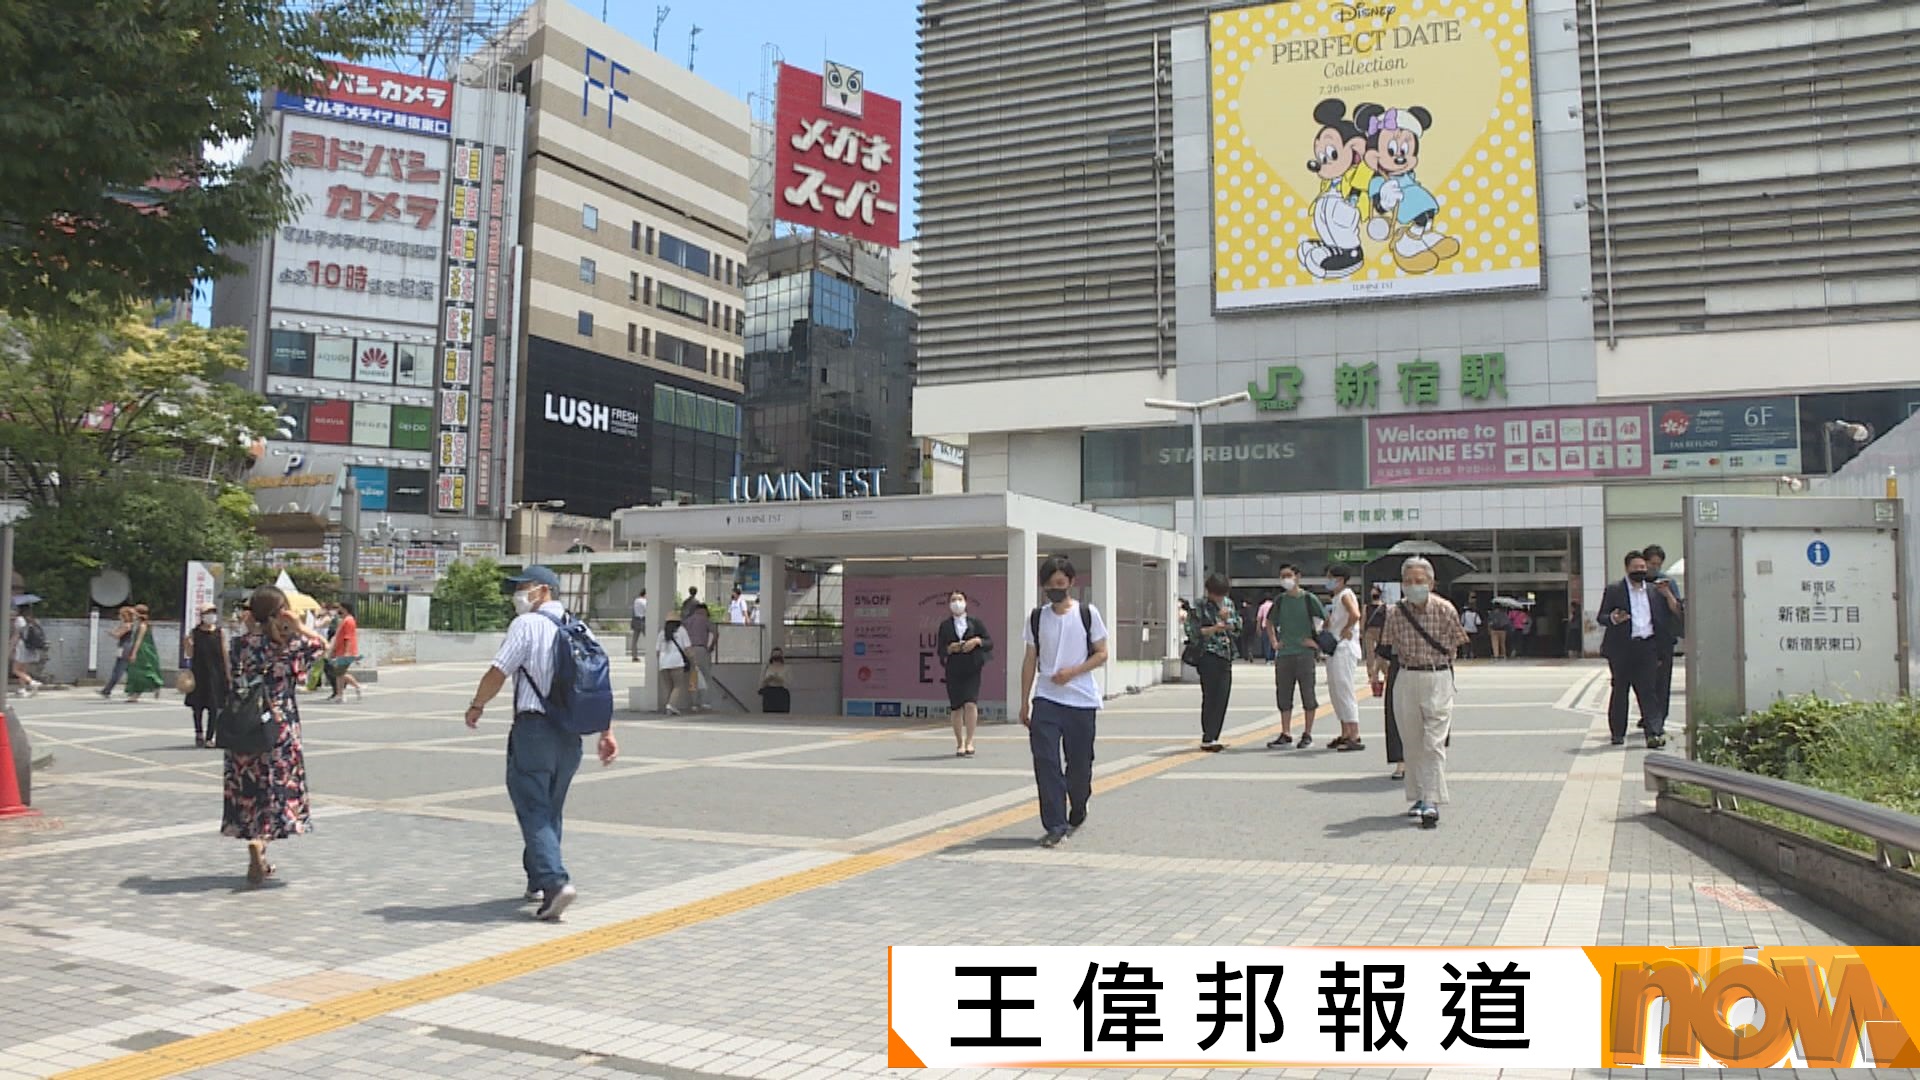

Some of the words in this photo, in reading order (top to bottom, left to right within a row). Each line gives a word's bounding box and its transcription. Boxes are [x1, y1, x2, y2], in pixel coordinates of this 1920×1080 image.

[1330, 1, 1397, 23] Disney
[1272, 29, 1387, 64] PERFECT
[1393, 20, 1462, 49] DATE
[1324, 56, 1408, 80] Collection
[289, 130, 442, 185] ヨドバシ
[790, 117, 893, 172] メガネ
[325, 183, 440, 231] カメラ
[783, 163, 898, 226] スーパー
[1247, 366, 1304, 401] JR
[1335, 352, 1509, 408] 新宿駅
[544, 392, 609, 432] LUSH
[611, 407, 639, 424] FRESH
[1744, 406, 1774, 427] 6F
[1376, 424, 1469, 444] Welcome
[1474, 424, 1497, 439] to
[1158, 441, 1296, 465] STARBUCKS
[1377, 443, 1457, 464] LUMINE
[1461, 441, 1497, 460] EST
[729, 470, 830, 504] LUMINE
[839, 467, 887, 498] EST
[1801, 580, 1836, 593] 新宿区
[1778, 606, 1860, 623] 新宿三丁目
